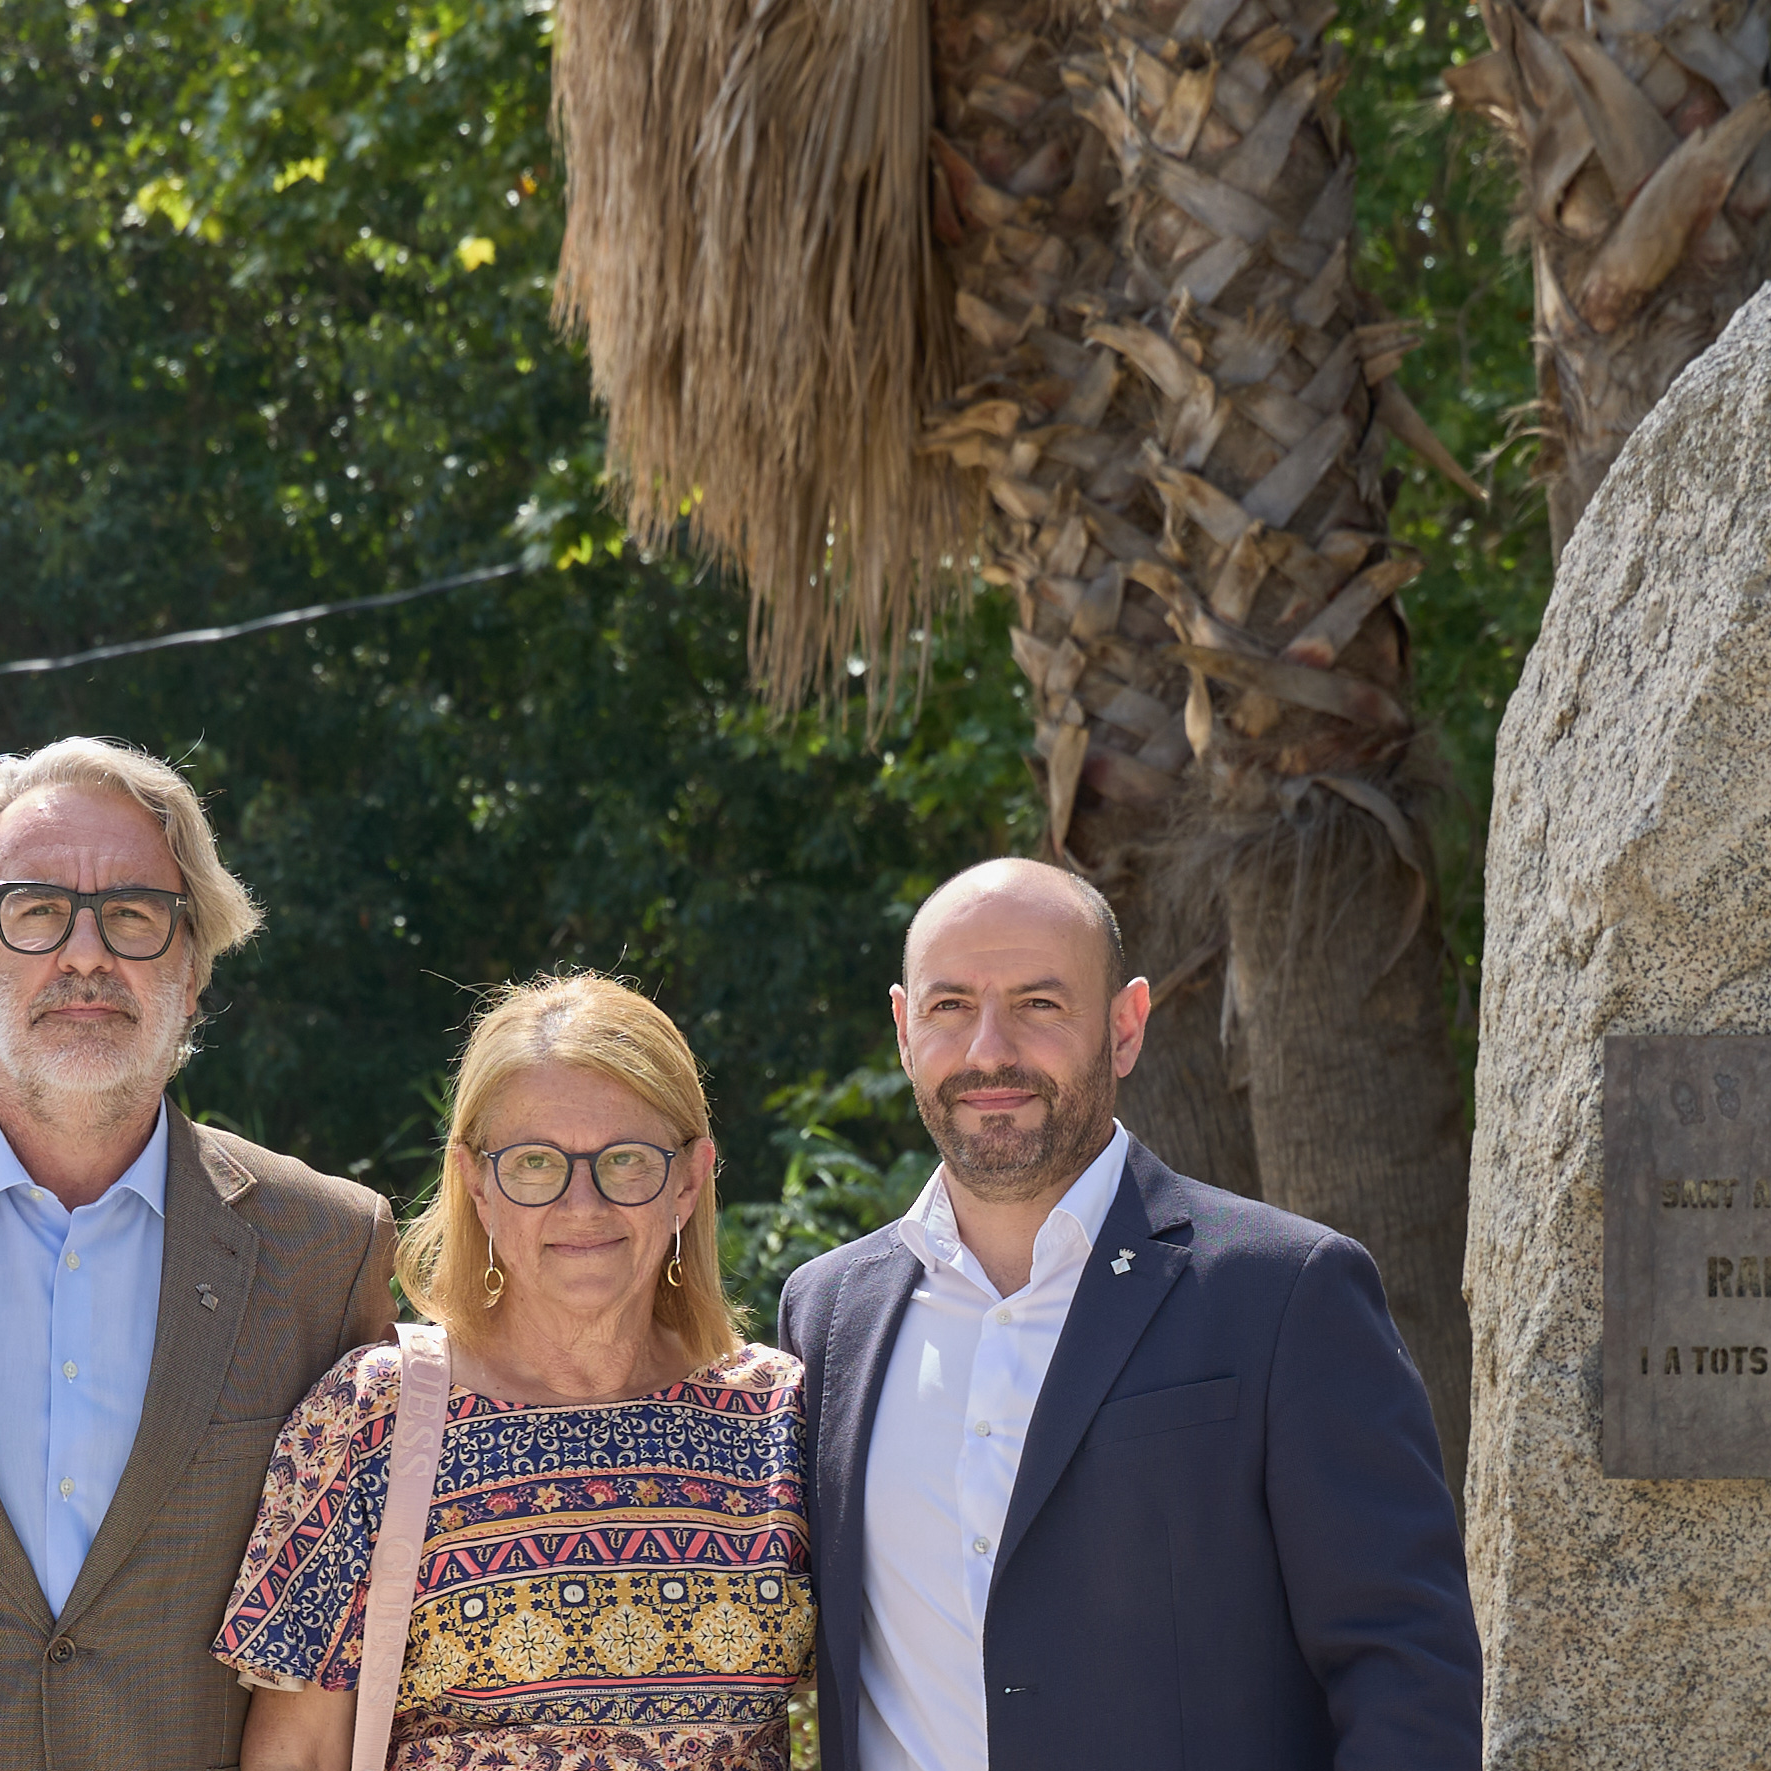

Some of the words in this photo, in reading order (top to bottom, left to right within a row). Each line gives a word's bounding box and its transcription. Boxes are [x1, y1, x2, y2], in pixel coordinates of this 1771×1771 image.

[1660, 1178, 1740, 1210] SANT
[1639, 1346, 1649, 1376] I
[1663, 1346, 1681, 1376] A
[1691, 1346, 1769, 1376] TOTS
